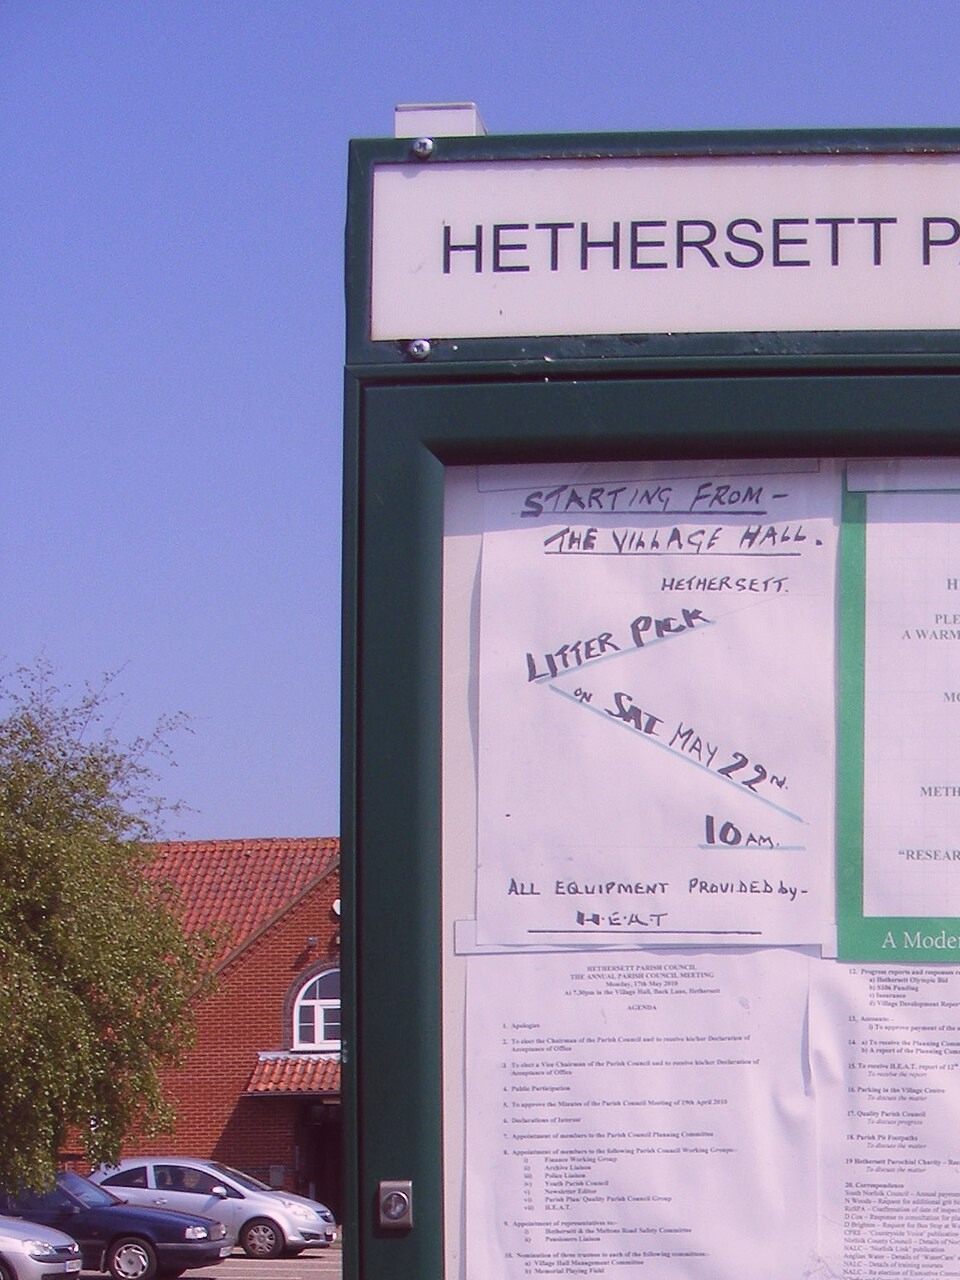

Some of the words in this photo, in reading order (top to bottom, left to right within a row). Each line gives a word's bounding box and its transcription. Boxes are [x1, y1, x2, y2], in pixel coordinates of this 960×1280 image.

[443, 218, 897, 274] HETHERSETT
[520, 485, 673, 517] STARTING
[545, 527, 598, 552] THE
[613, 526, 721, 553] VILLAGE
[526, 632, 620, 682] LITTER
[630, 608, 711, 648] PICK
[902, 629, 912, 640] A
[605, 692, 665, 736] SAT
[670, 722, 718, 766] MAY
[508, 879, 540, 896] ALL
[556, 881, 669, 895] EQUIPMENT
[689, 879, 773, 895] PROVIDED
[882, 932, 896, 949] A
